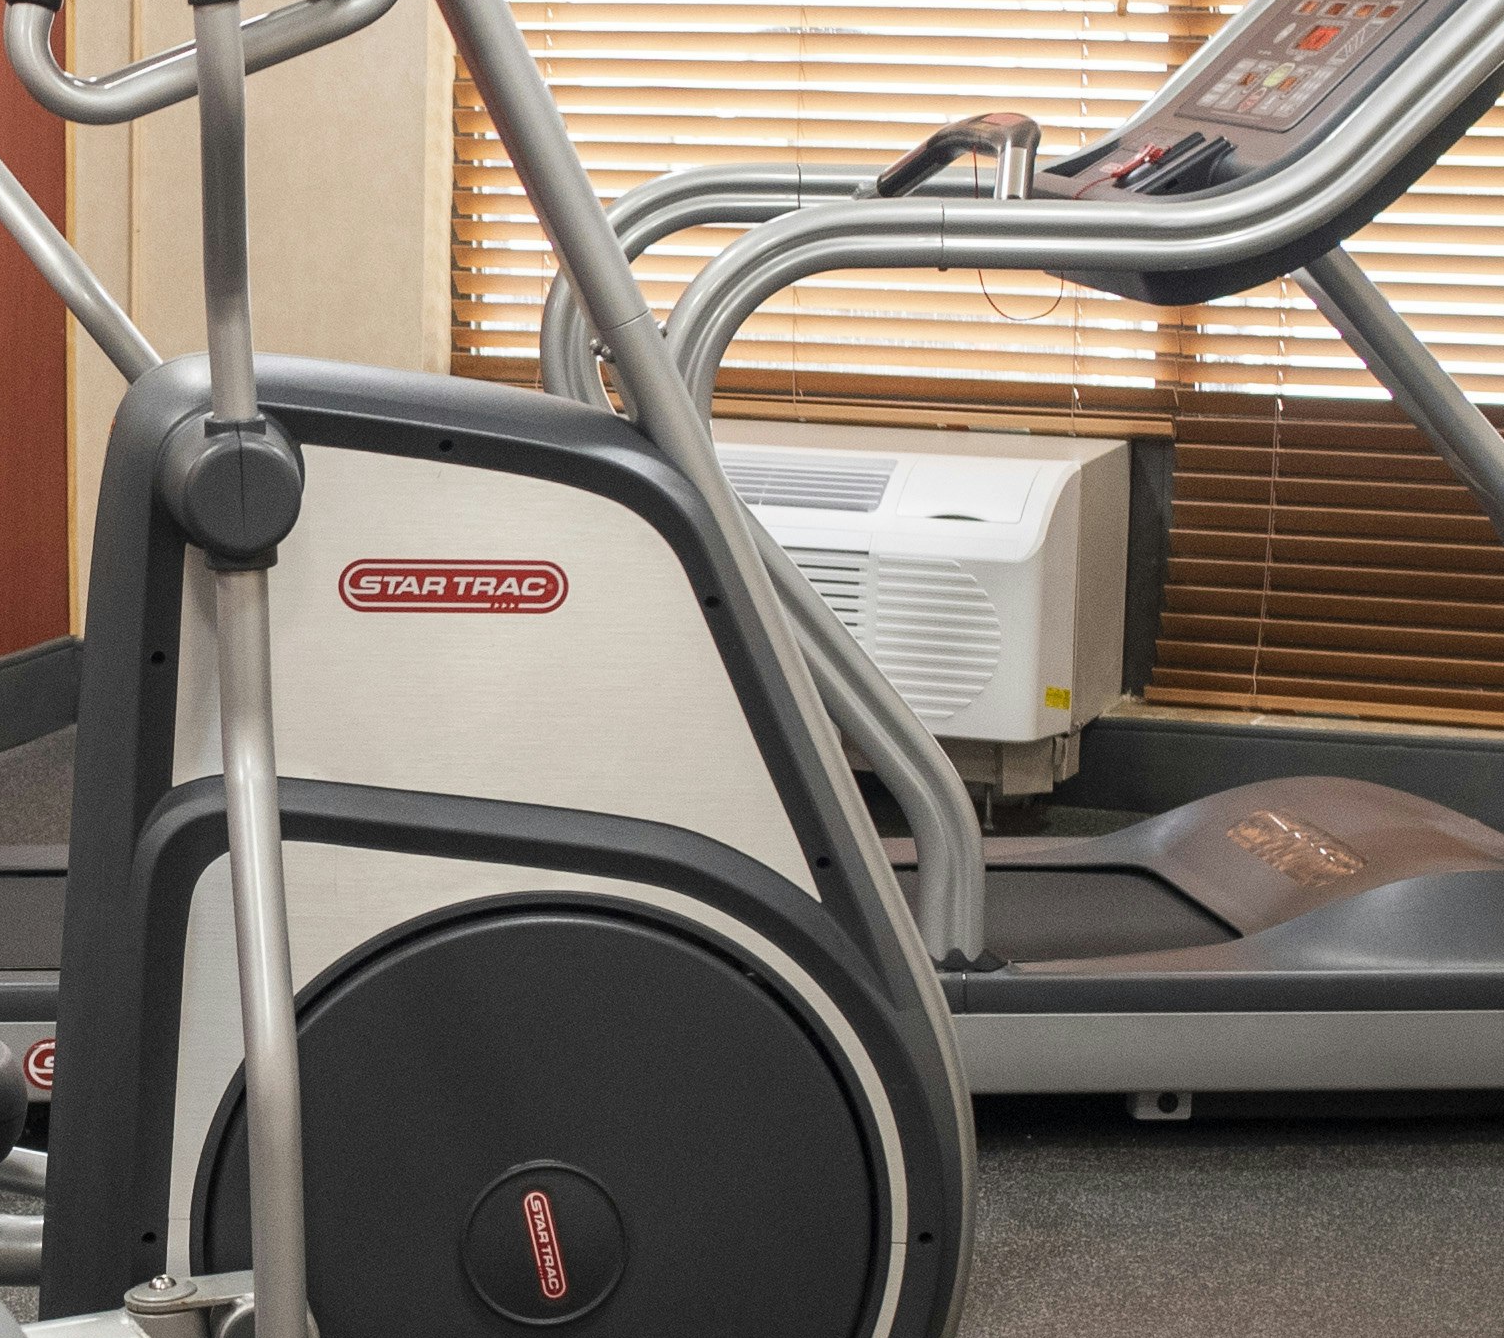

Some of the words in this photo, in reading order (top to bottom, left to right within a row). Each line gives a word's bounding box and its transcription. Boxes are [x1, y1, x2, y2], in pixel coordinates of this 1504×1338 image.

[350, 575, 447, 596] STAR
[453, 576, 548, 597] TRAC
[530, 1196, 549, 1243] STAR
[541, 1245, 560, 1290] TRAC
